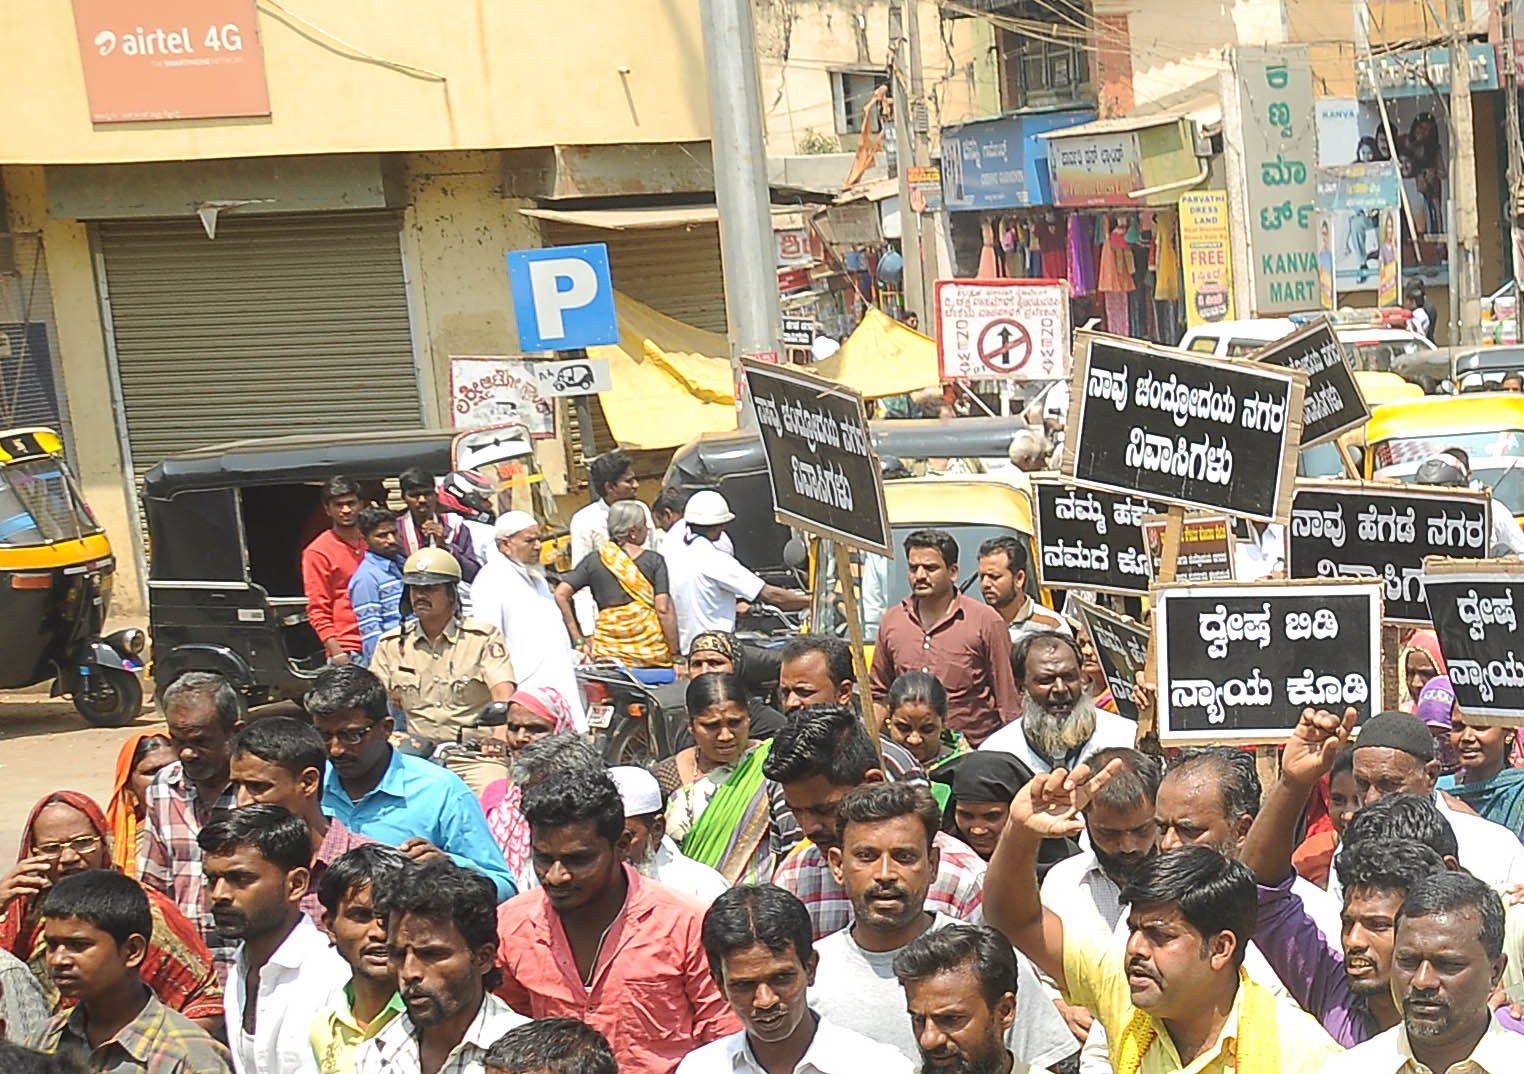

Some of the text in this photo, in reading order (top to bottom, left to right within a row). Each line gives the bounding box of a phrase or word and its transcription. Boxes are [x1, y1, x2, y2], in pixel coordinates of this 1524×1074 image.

[122, 24, 242, 56] airtel 4G
[1322, 110, 1355, 118] KANVA
[1190, 249, 1225, 265] FREE
[1262, 251, 1319, 275] KANVA
[529, 258, 598, 340] P
[1269, 280, 1316, 303] MART
[1090, 366, 1286, 434] ನಾವು ಚಂದ್ರೋದಯ ನಗರ
[1303, 379, 1344, 426] ವಾಸಿಗಳು
[755, 393, 868, 457] ನಾವು ಚಂದ್ರೋದಯ ನಗರ
[1126, 427, 1232, 485] ನಿವಾಸಿಗಳು
[791, 455, 853, 512] ನಿವಾಸಿಗಳು
[1054, 491, 1107, 535] ನಮ್ಮ
[1290, 500, 1483, 547] ನಾವು ಹೆಗಡೆ ನಗರ
[1043, 538, 1109, 571] ನಮಗೆ
[1117, 547, 1150, 576] ಕೊ
[1199, 603, 1338, 658] ದ್ವೇಷ ಬಿಡಿ
[1457, 588, 1516, 640] ದ್ವೇಷ
[1171, 669, 1368, 730] ನ್ಯಾಯ ಕೊಡಿ
